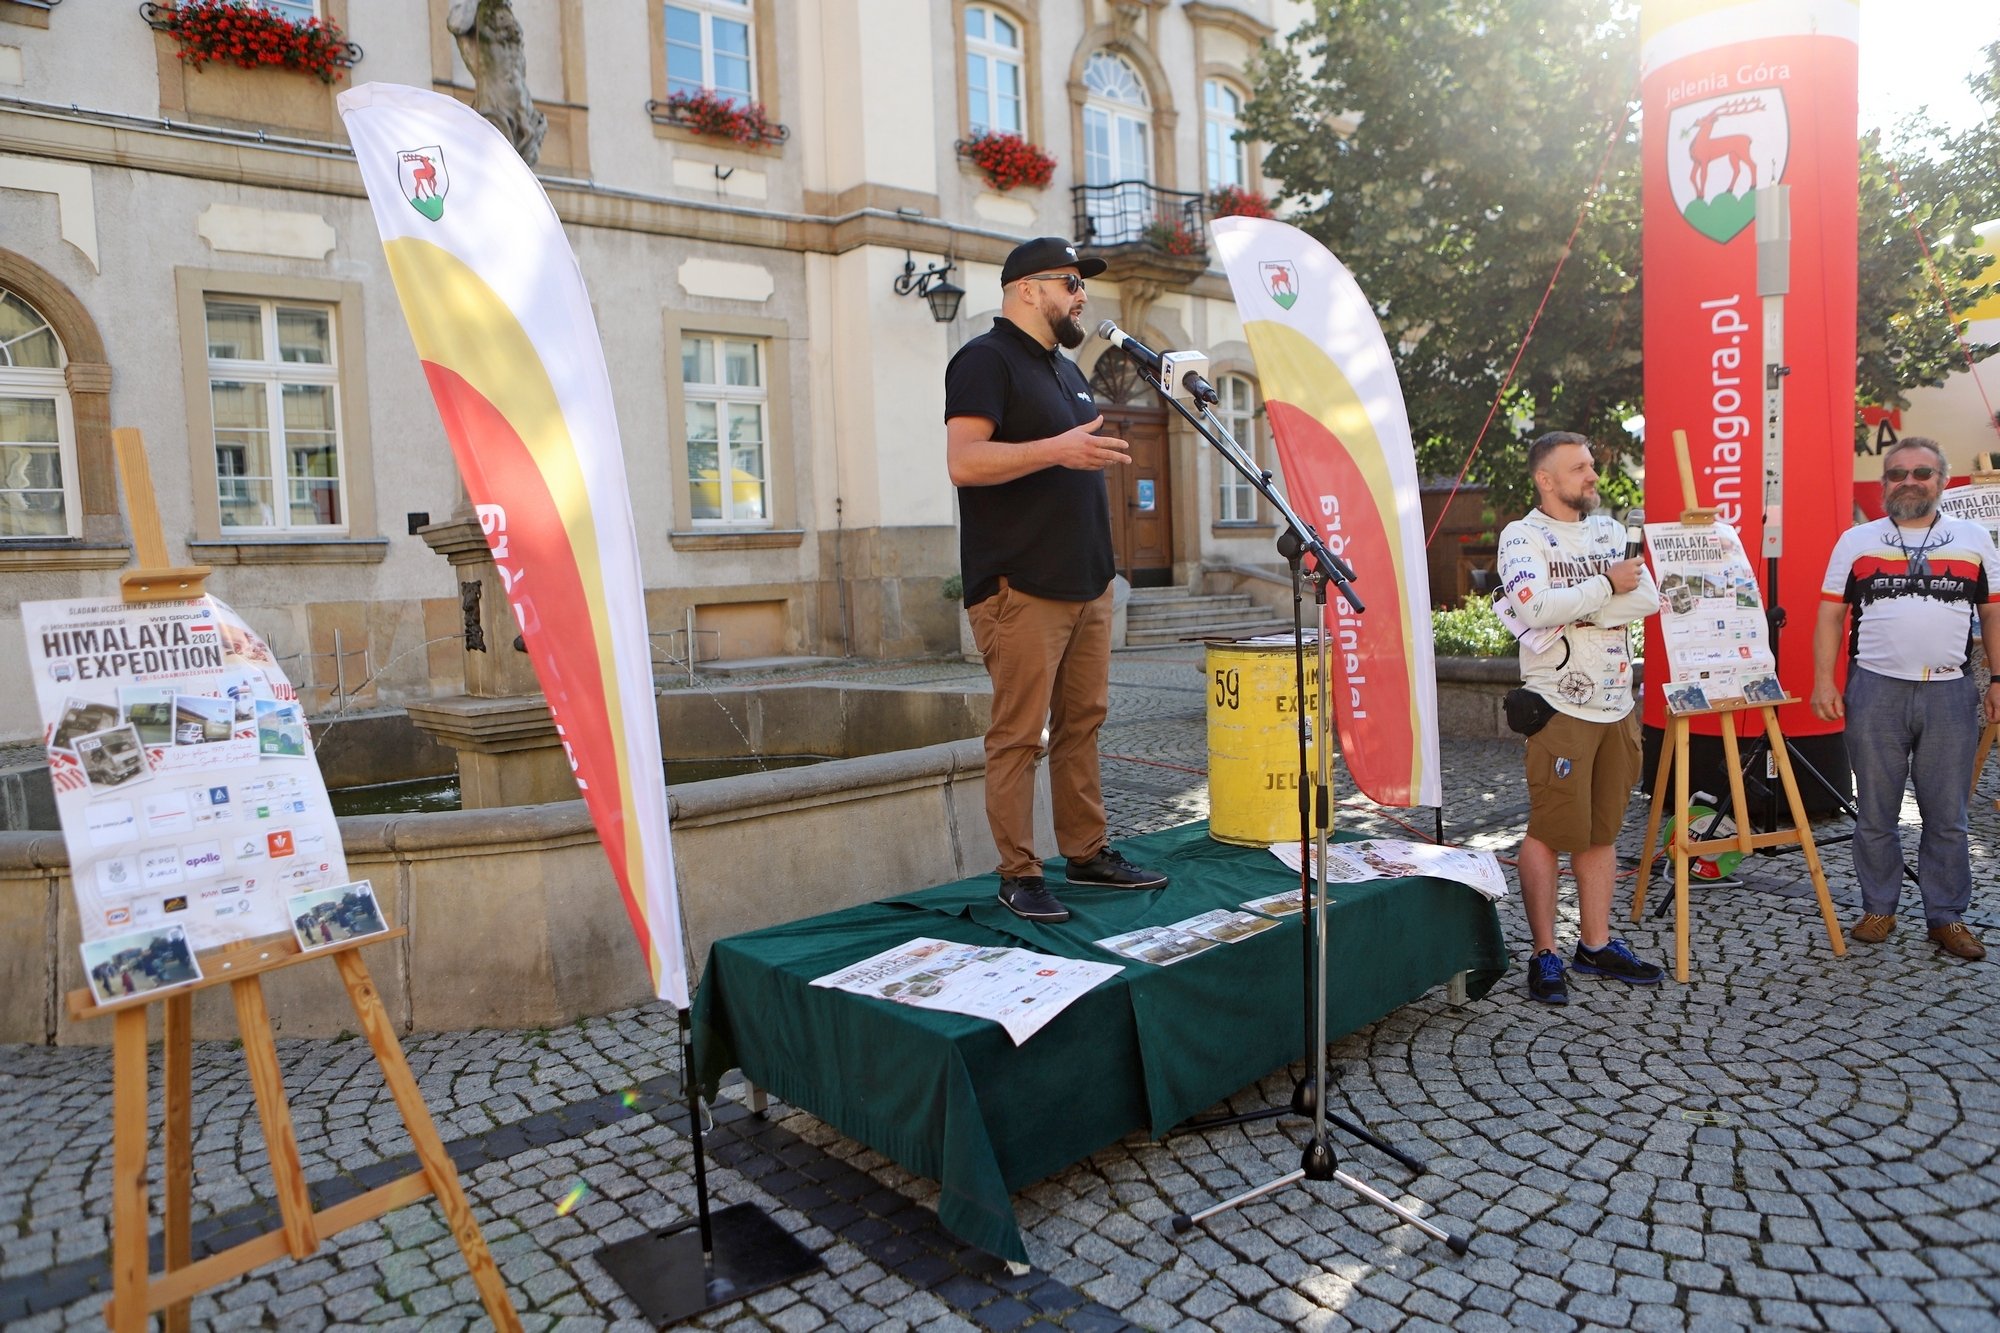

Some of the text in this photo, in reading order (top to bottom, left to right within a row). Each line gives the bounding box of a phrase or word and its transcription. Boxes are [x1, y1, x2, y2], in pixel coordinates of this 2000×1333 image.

[1664, 61, 1791, 108] Jelenia Góra
[1700, 294, 1750, 535] eniagora.pl
[1941, 494, 2000, 512] HIMALAYA
[1653, 536, 1709, 550] HIMALAYA
[1667, 548, 1722, 562] EXPEDITION
[1505, 570, 1536, 594] apollo
[1871, 577, 1965, 592] JELENA GÓRA
[169, 613, 202, 622] GROUP
[42, 621, 218, 658] HIMALAYA 2021
[76, 645, 223, 680] EXPEDITION
[1215, 668, 1240, 710] 59
[186, 852, 221, 868] apollo
